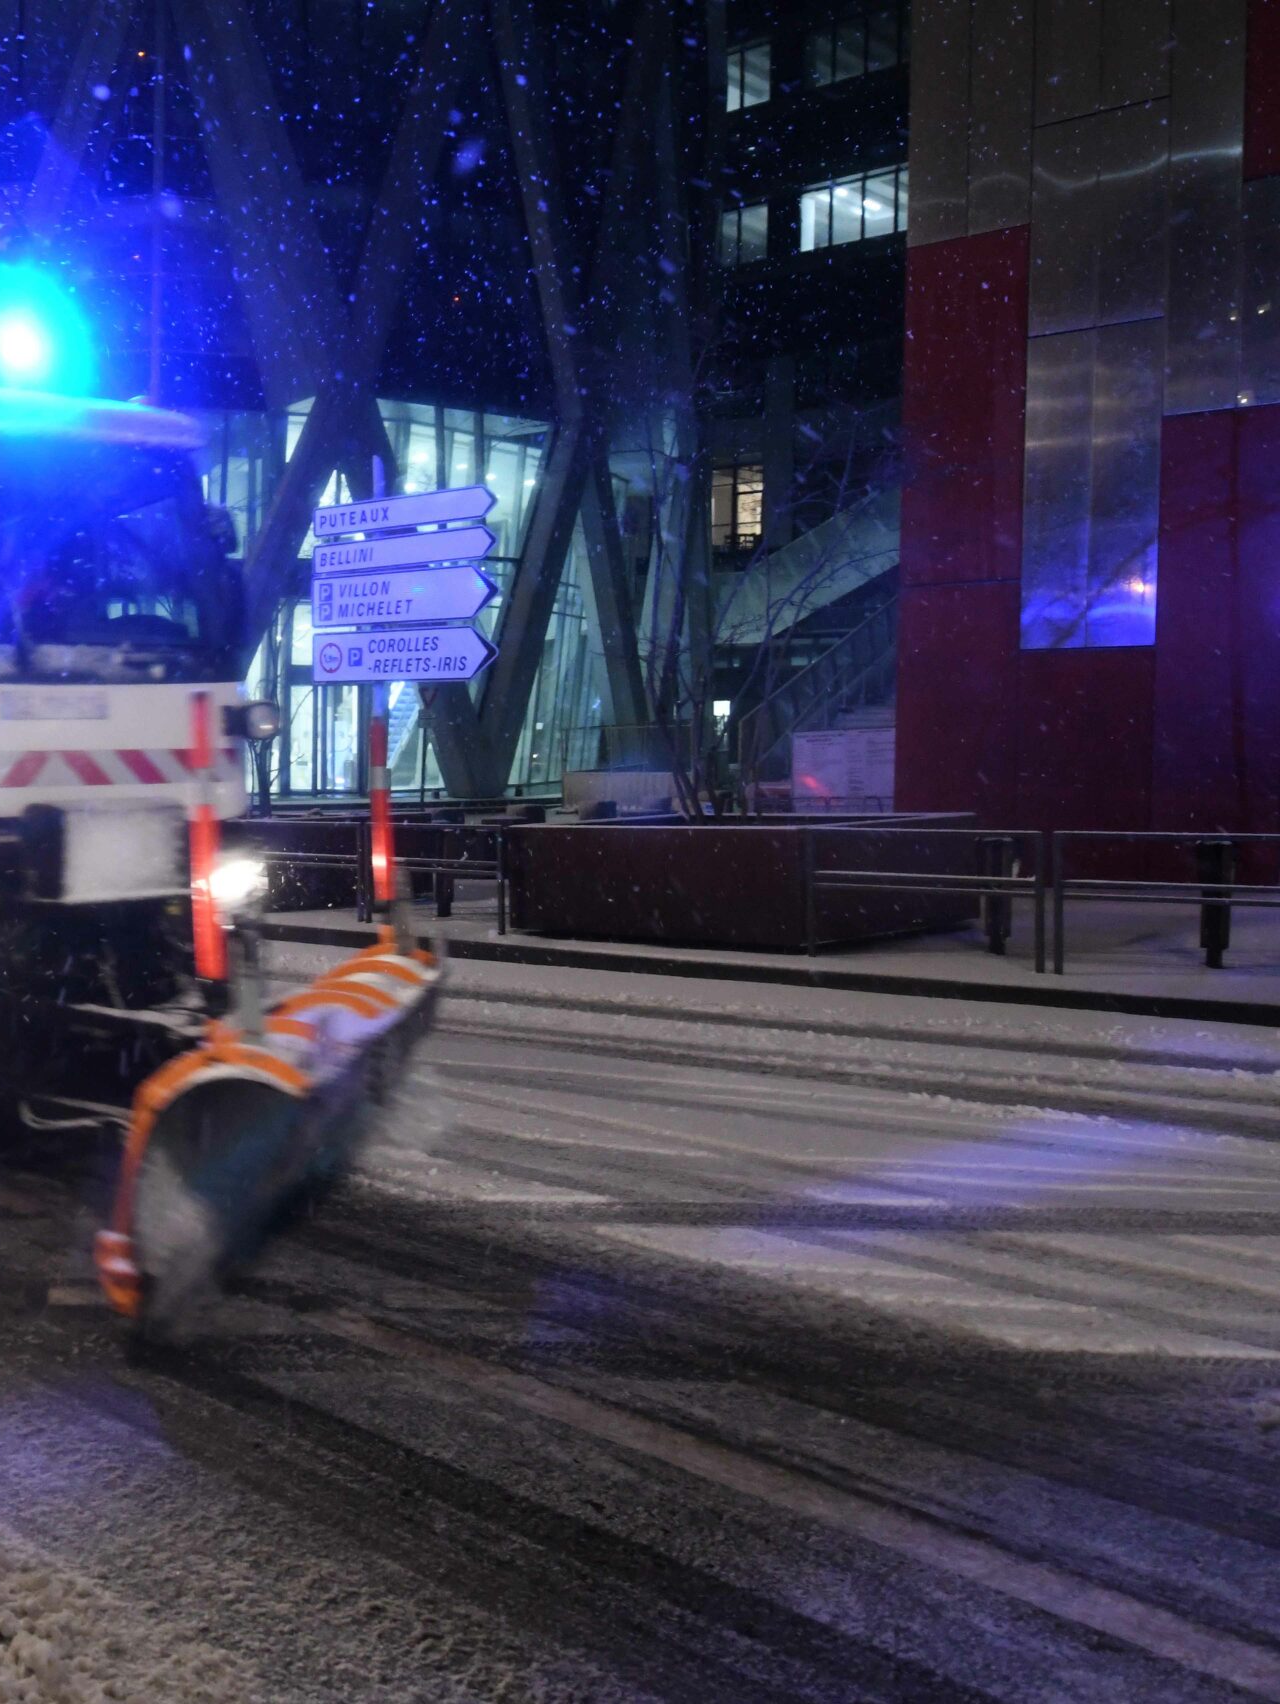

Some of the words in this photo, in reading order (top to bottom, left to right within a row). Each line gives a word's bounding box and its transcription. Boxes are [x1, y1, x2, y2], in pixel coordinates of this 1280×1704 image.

[319, 507, 389, 529] PUTEAUX
[320, 547, 373, 567] BELLINI
[339, 581, 390, 598] VILLON
[338, 599, 413, 618] MICHELET
[368, 636, 439, 653] COROLLES
[368, 656, 468, 673] -REFLETS-IRIS
